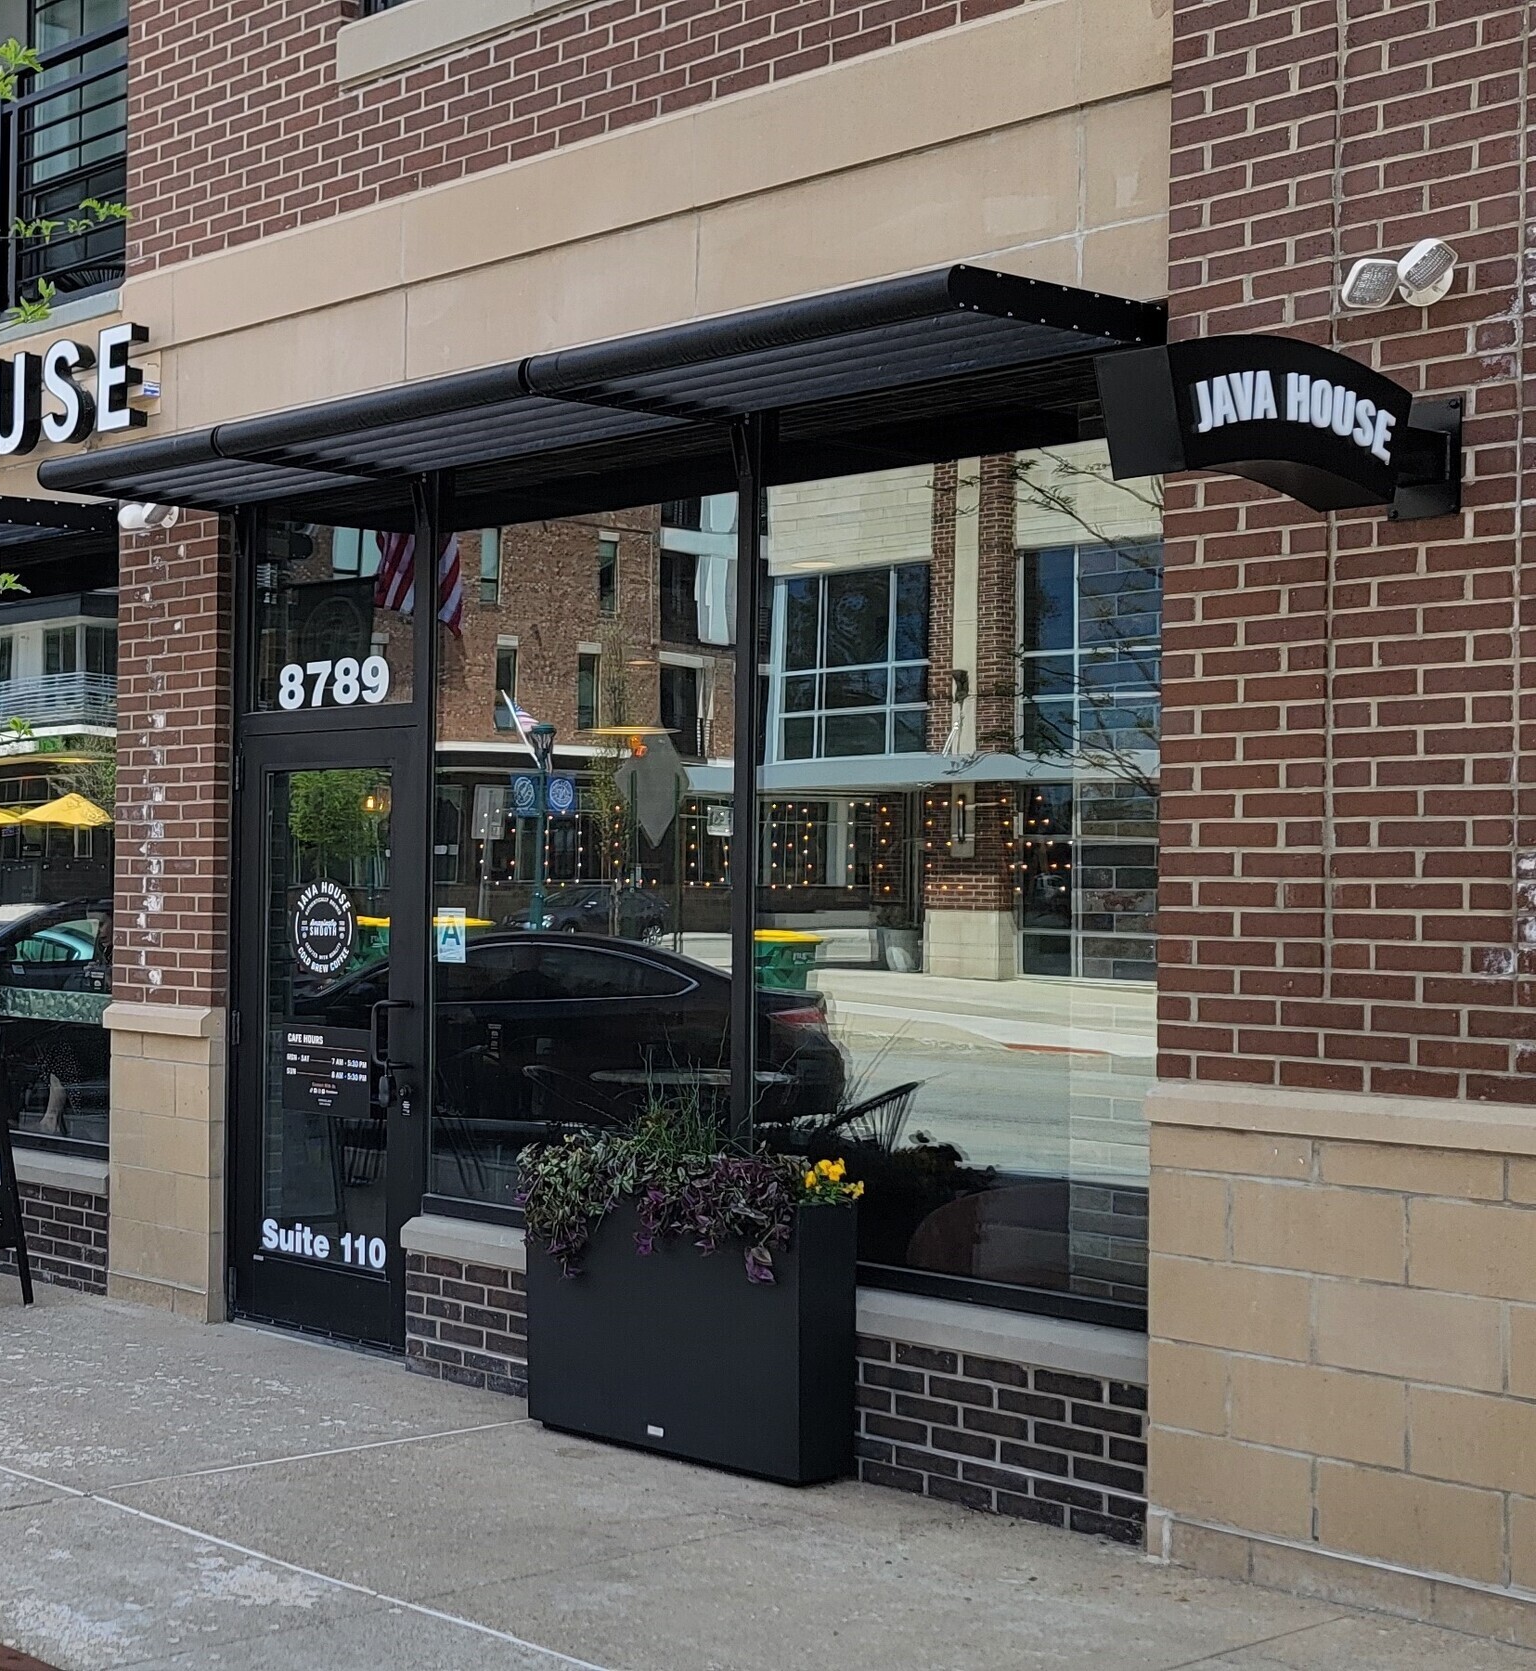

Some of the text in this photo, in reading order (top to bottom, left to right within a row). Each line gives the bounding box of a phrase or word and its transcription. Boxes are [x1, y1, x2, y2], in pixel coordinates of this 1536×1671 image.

[1195, 370, 1397, 466] JAVA HOUSE
[278, 655, 390, 710] 8789
[297, 881, 352, 912] JAVA HOUSE
[309, 926, 337, 937] SMOOTH
[441, 919, 461, 946] A
[297, 946, 350, 974] COLD BREW COFFEE
[287, 1033, 324, 1045] CAFE HOURS
[286, 1067, 297, 1075] SUN
[335, 1071, 344, 1080] AM
[347, 1072, 359, 1081] 5:30
[358, 1073, 368, 1082] PM
[335, 1058, 344, 1066] AM
[347, 1059, 359, 1069] 5:30
[358, 1060, 368, 1069] PM
[262, 1218, 386, 1268] Suite 110
